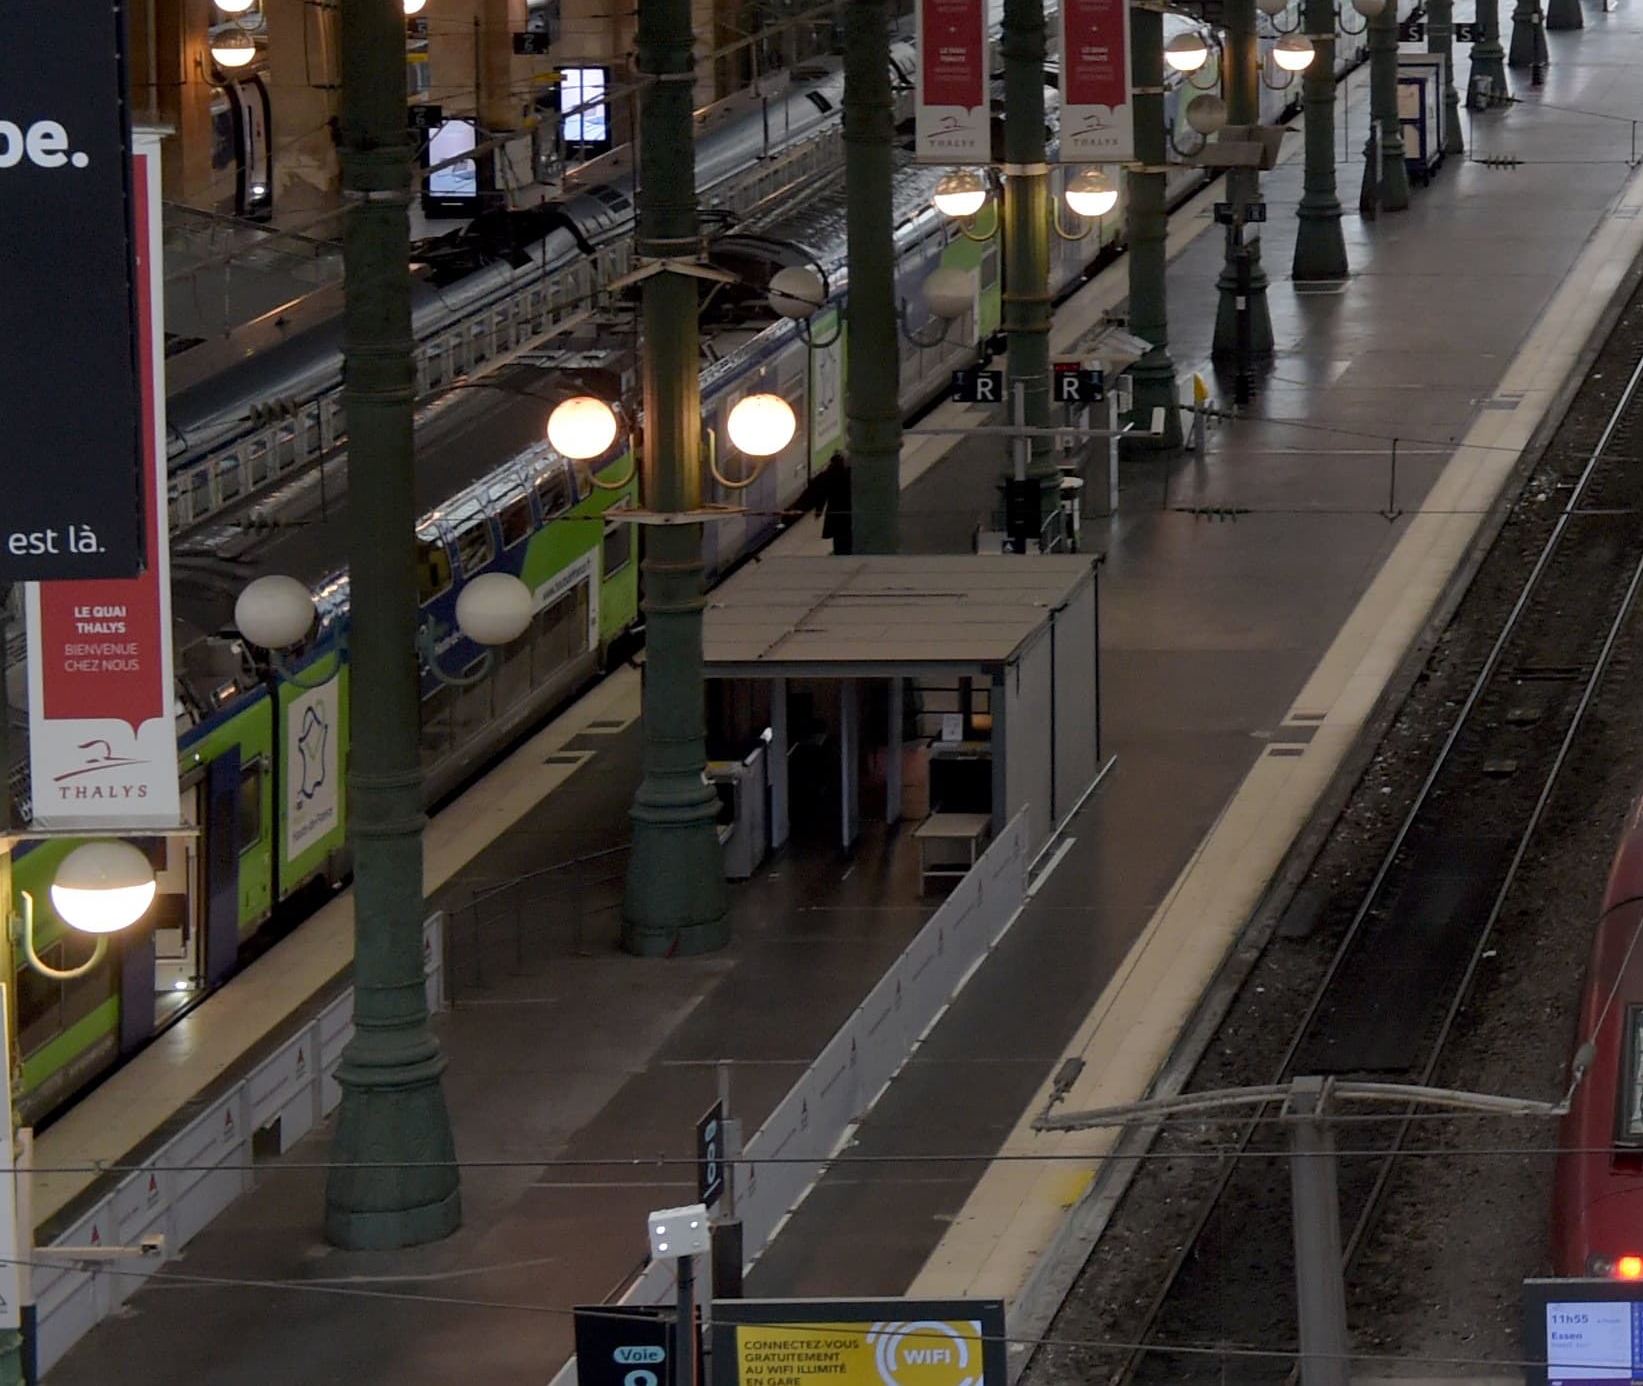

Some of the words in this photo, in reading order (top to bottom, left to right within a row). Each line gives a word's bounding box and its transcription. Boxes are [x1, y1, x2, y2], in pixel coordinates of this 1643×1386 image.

[8, 530, 59, 555] est
[69, 525, 107, 554] là.
[74, 607, 91, 618] LE
[94, 606, 127, 618] QUAI
[76, 621, 126, 634] THALYS
[64, 642, 139, 656] BIENVENUE
[64, 658, 99, 672] CHEZ
[102, 658, 140, 672] NOUS
[59, 785, 149, 799] THALYS
[1551, 1315, 1589, 1324] 11h55
[745, 1340, 860, 1351] CONNECTEZ-VOUS
[620, 1348, 659, 1361] Voie
[745, 1352, 841, 1363] GRATUITEMENT
[903, 1349, 952, 1365] WIFI
[745, 1365, 765, 1375] AU
[767, 1365, 794, 1375] WIFI
[797, 1363, 848, 1375] ILLIMITÉ
